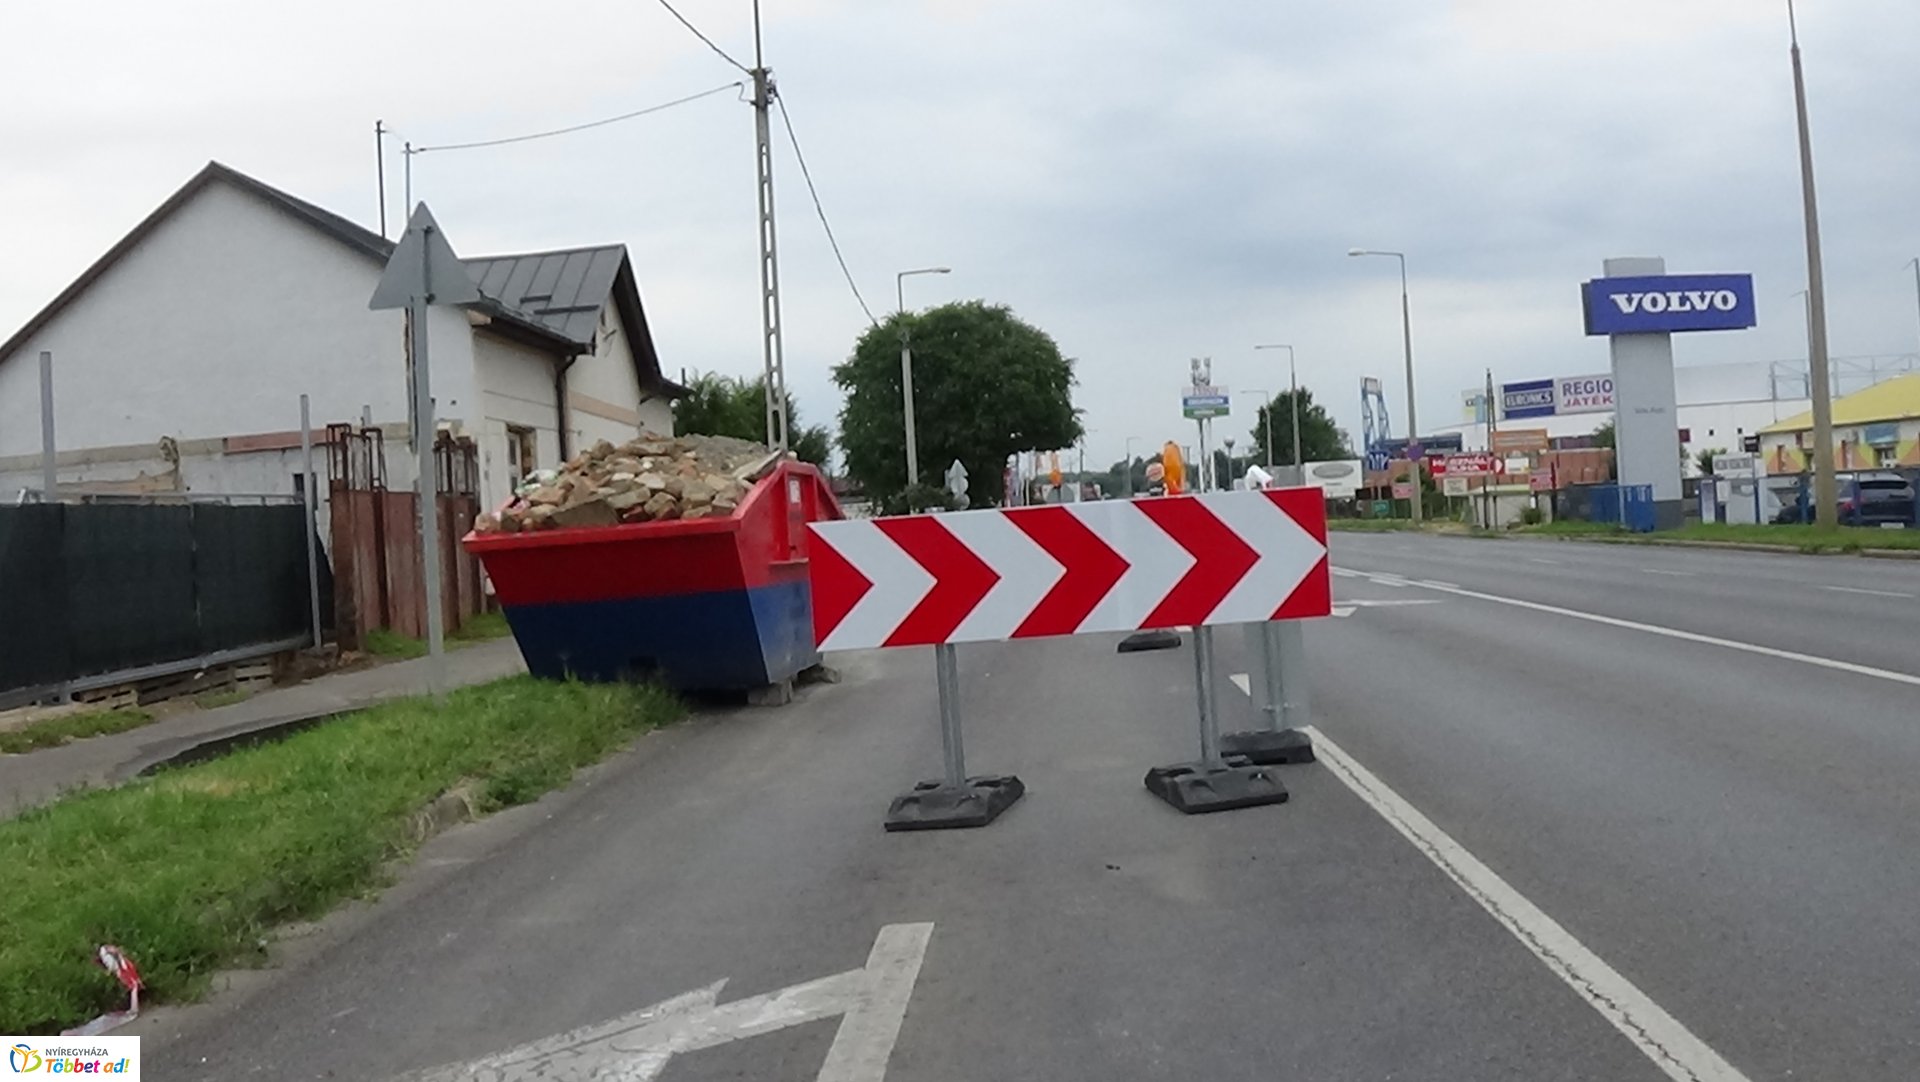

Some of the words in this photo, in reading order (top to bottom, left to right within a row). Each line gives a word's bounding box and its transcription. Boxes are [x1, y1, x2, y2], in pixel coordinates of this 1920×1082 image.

[1610, 290, 1737, 314] VOLVO
[1562, 379, 1613, 396] REGIO
[1506, 390, 1552, 407] EURONICS
[1563, 394, 1614, 408] JÁTÉK
